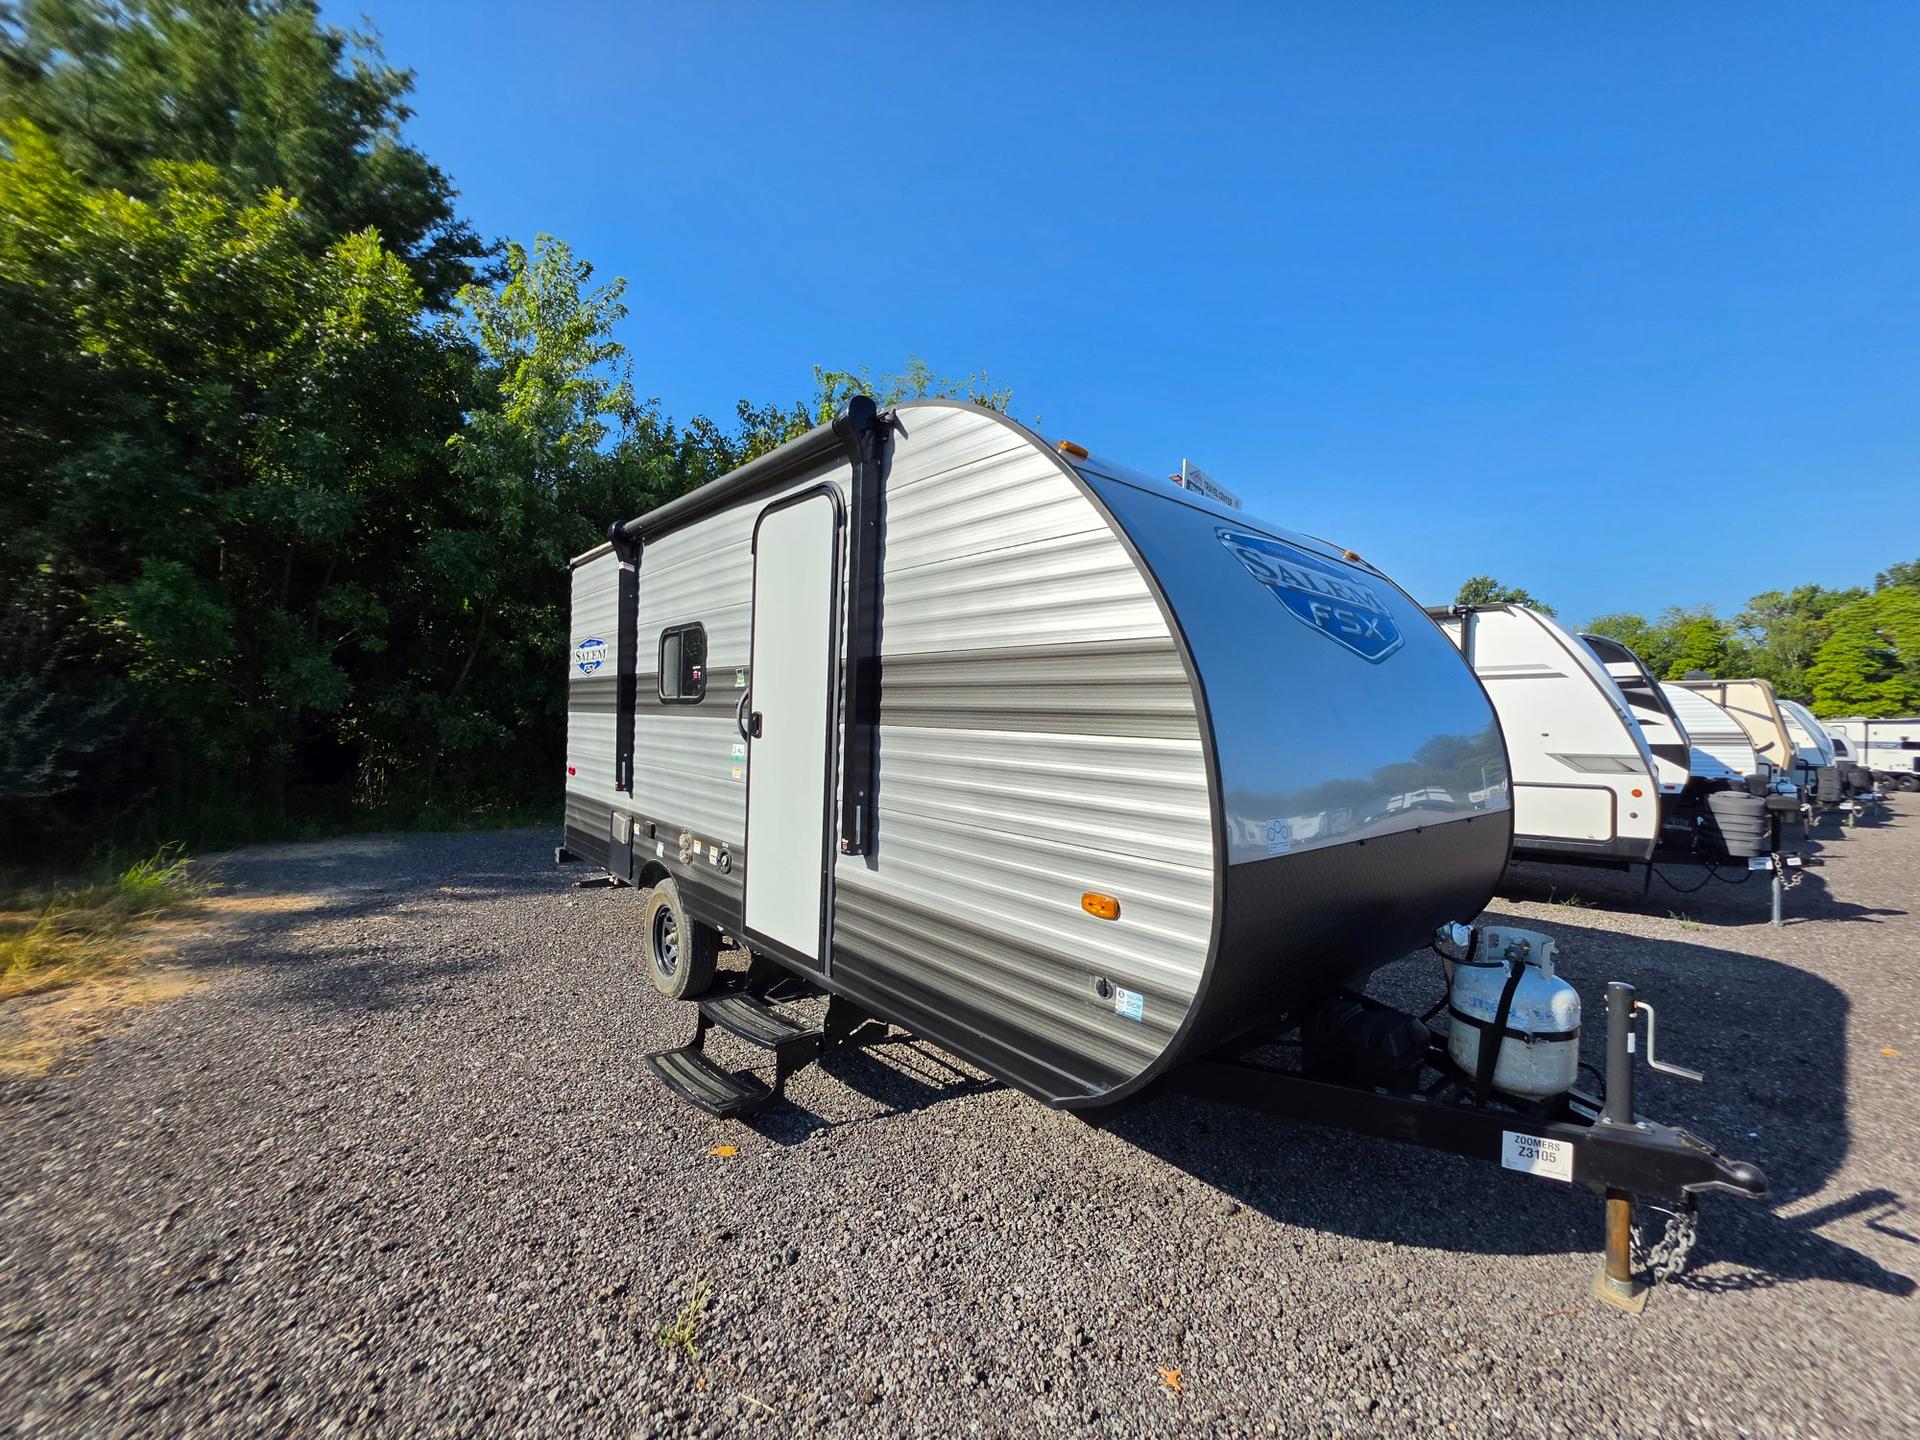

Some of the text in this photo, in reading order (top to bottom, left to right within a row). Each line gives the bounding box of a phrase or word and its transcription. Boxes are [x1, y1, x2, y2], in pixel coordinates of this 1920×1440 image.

[1236, 547, 1387, 613] SALEM
[1308, 601, 1388, 641] FSX
[576, 649, 605, 662] SALEM
[1514, 1135, 1561, 1152] ZOOMERS
[1518, 1145, 1557, 1163] Z3105
